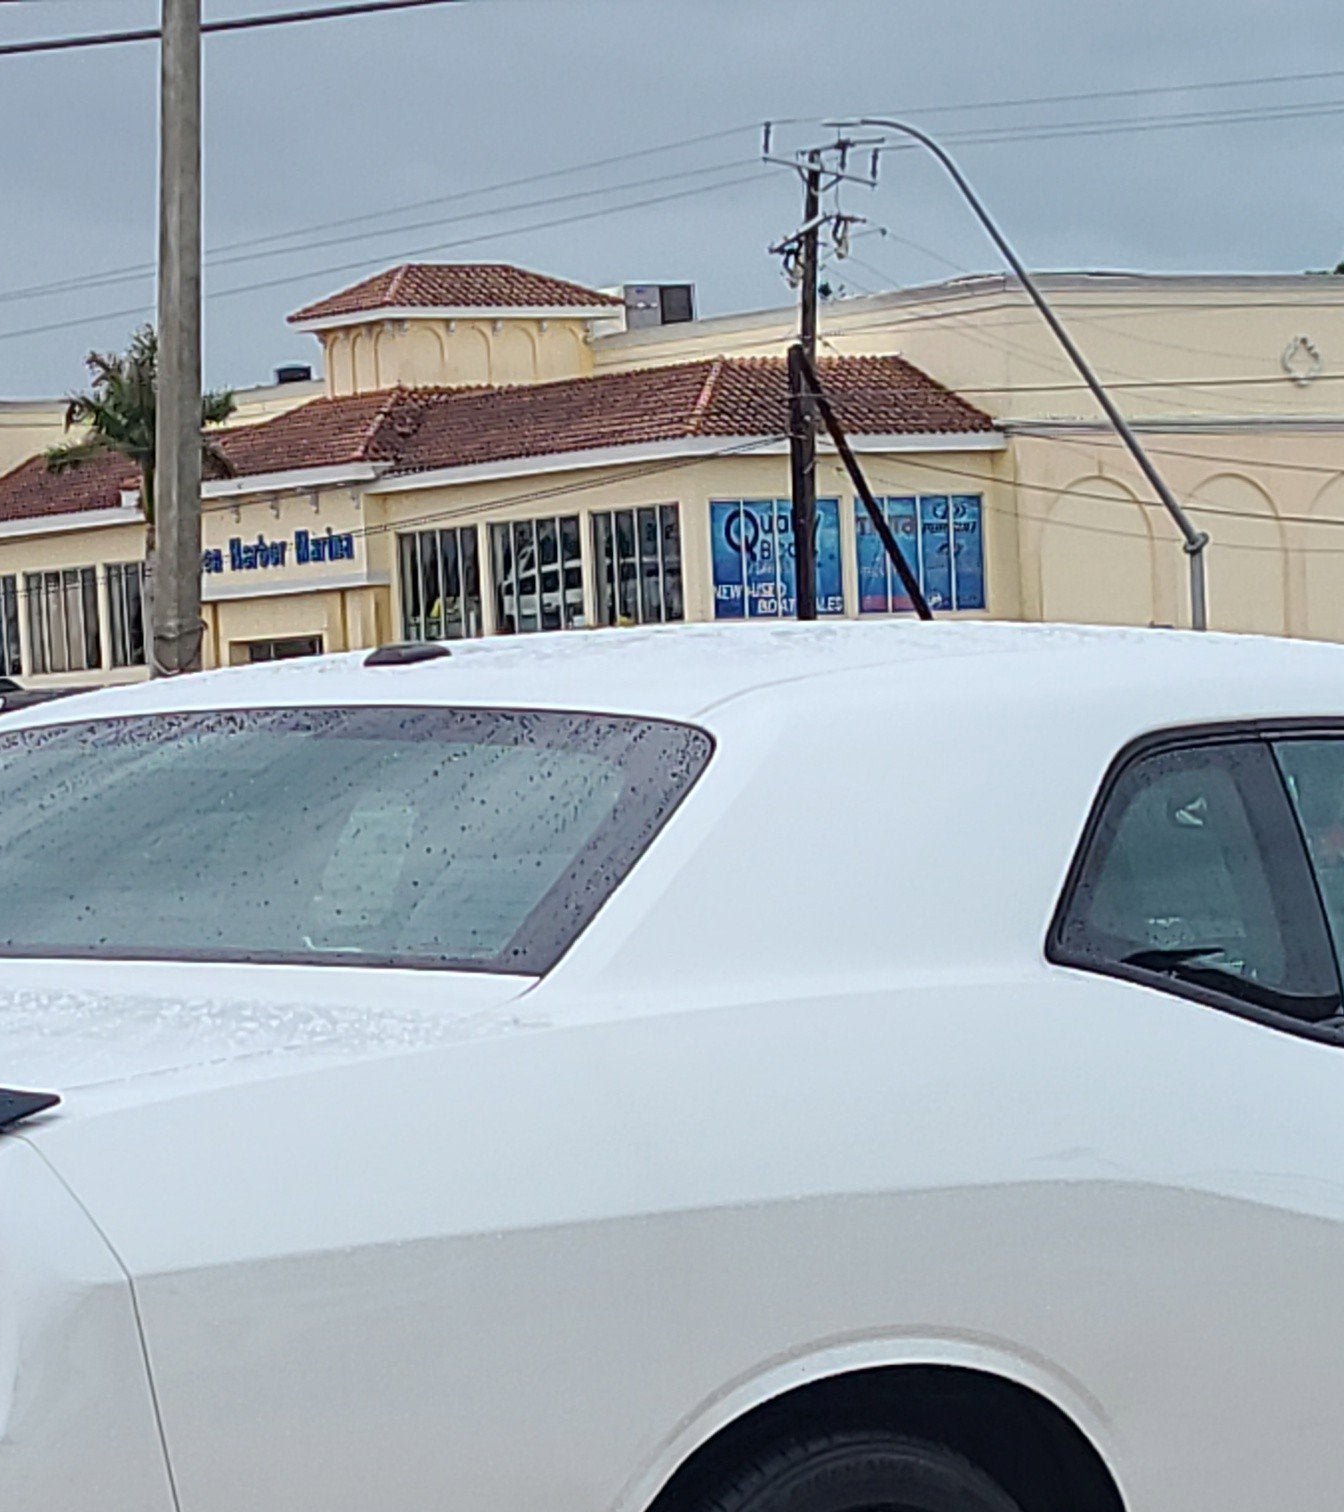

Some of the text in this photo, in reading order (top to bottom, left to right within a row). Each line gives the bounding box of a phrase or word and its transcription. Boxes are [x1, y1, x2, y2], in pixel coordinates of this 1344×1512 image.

[229, 534, 287, 571] Harbor
[295, 527, 354, 565] Marina
[724, 508, 822, 561] Quay
